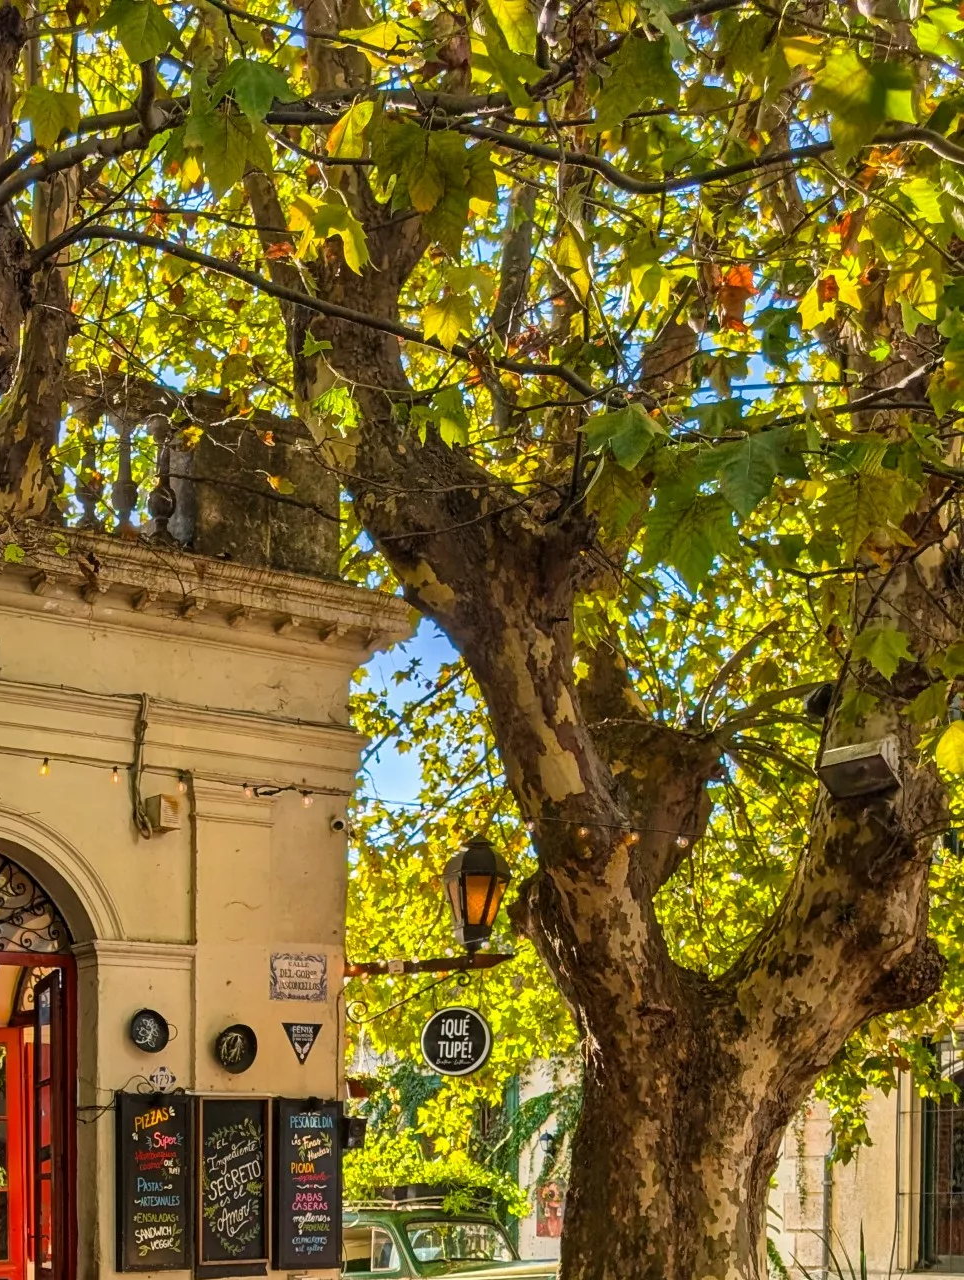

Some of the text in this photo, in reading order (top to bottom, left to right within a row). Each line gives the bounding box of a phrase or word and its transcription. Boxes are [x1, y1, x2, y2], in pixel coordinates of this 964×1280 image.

[279, 969, 295, 978] DEL
[292, 1025, 314, 1034] FÉNIX
[440, 1014, 471, 1038] ¡QUÉ
[437, 1036, 472, 1059] TUPÉ!
[134, 1107, 169, 1132] PIZZAS
[289, 1114, 334, 1129] PESCA DEL DÍA
[206, 1139, 258, 1176] Ingrediente
[290, 1161, 315, 1175] PICADA
[137, 1177, 164, 1193] PASTAS
[208, 1159, 262, 1201] SECRETO
[140, 1195, 181, 1207] ARTESANALES
[220, 1184, 247, 1208] es el
[296, 1192, 323, 1202] RABAS
[291, 1202, 328, 1211] CASERAS
[136, 1212, 176, 1224] ENSALADAS
[217, 1199, 253, 1238] Amor
[134, 1225, 173, 1244] SANDWICH
